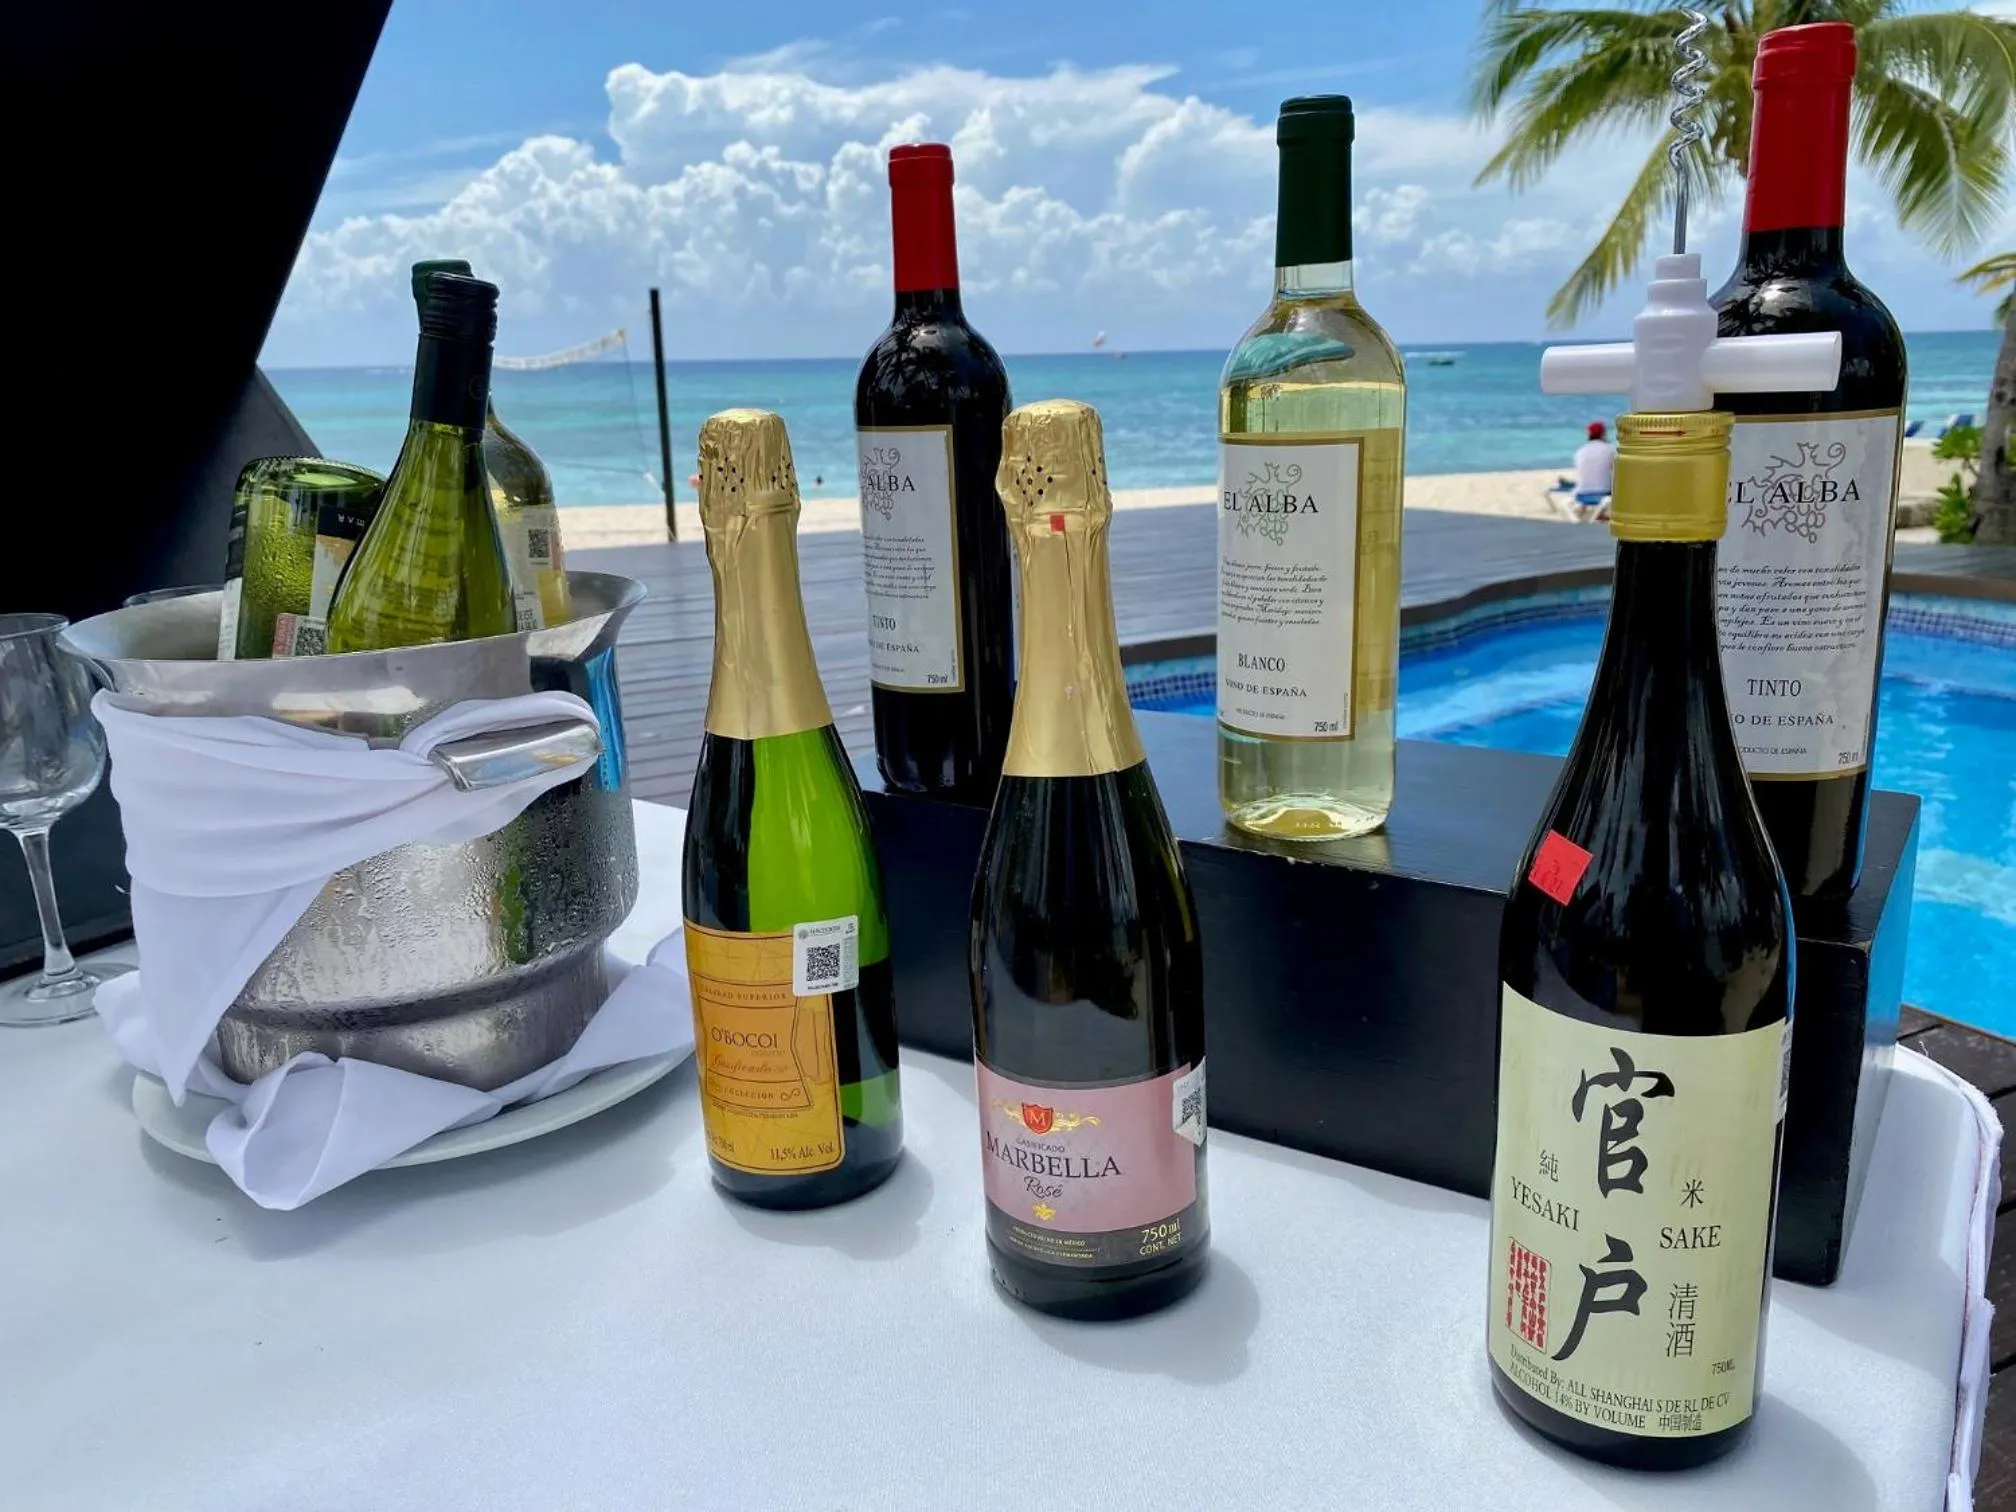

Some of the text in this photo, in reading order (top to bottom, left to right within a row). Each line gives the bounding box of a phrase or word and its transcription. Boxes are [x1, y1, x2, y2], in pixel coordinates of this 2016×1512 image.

[867, 475, 915, 492] ALBA
[1727, 478, 1861, 505] L ALBA
[1224, 491, 1319, 514] EL ALBA
[886, 642, 920, 653] ESPAÑA
[1238, 653, 1286, 673] BLANCO
[1225, 678, 1308, 698] VINO DE ESPAÑA
[1747, 678, 1802, 697] TINTO
[1751, 714, 1772, 726] DE
[1778, 711, 1835, 727] ESPAÑA
[1030, 1111, 1047, 1126] M
[986, 1130, 1123, 1178] MARBELLA
[1023, 1175, 1064, 1200] Rosé
[1680, 1178, 1705, 1209] 米
[1510, 1175, 1580, 1232] YESAKI
[1659, 1225, 1721, 1250] SAKE
[1509, 1361, 1646, 1429] ALCOHOL 14% BY VOLUME
[1567, 1379, 1588, 1398] ALL
[1590, 1386, 1653, 1413] SHANGHAI
[1665, 1400, 1681, 1413] DE
[1701, 1396, 1715, 1411] DE
